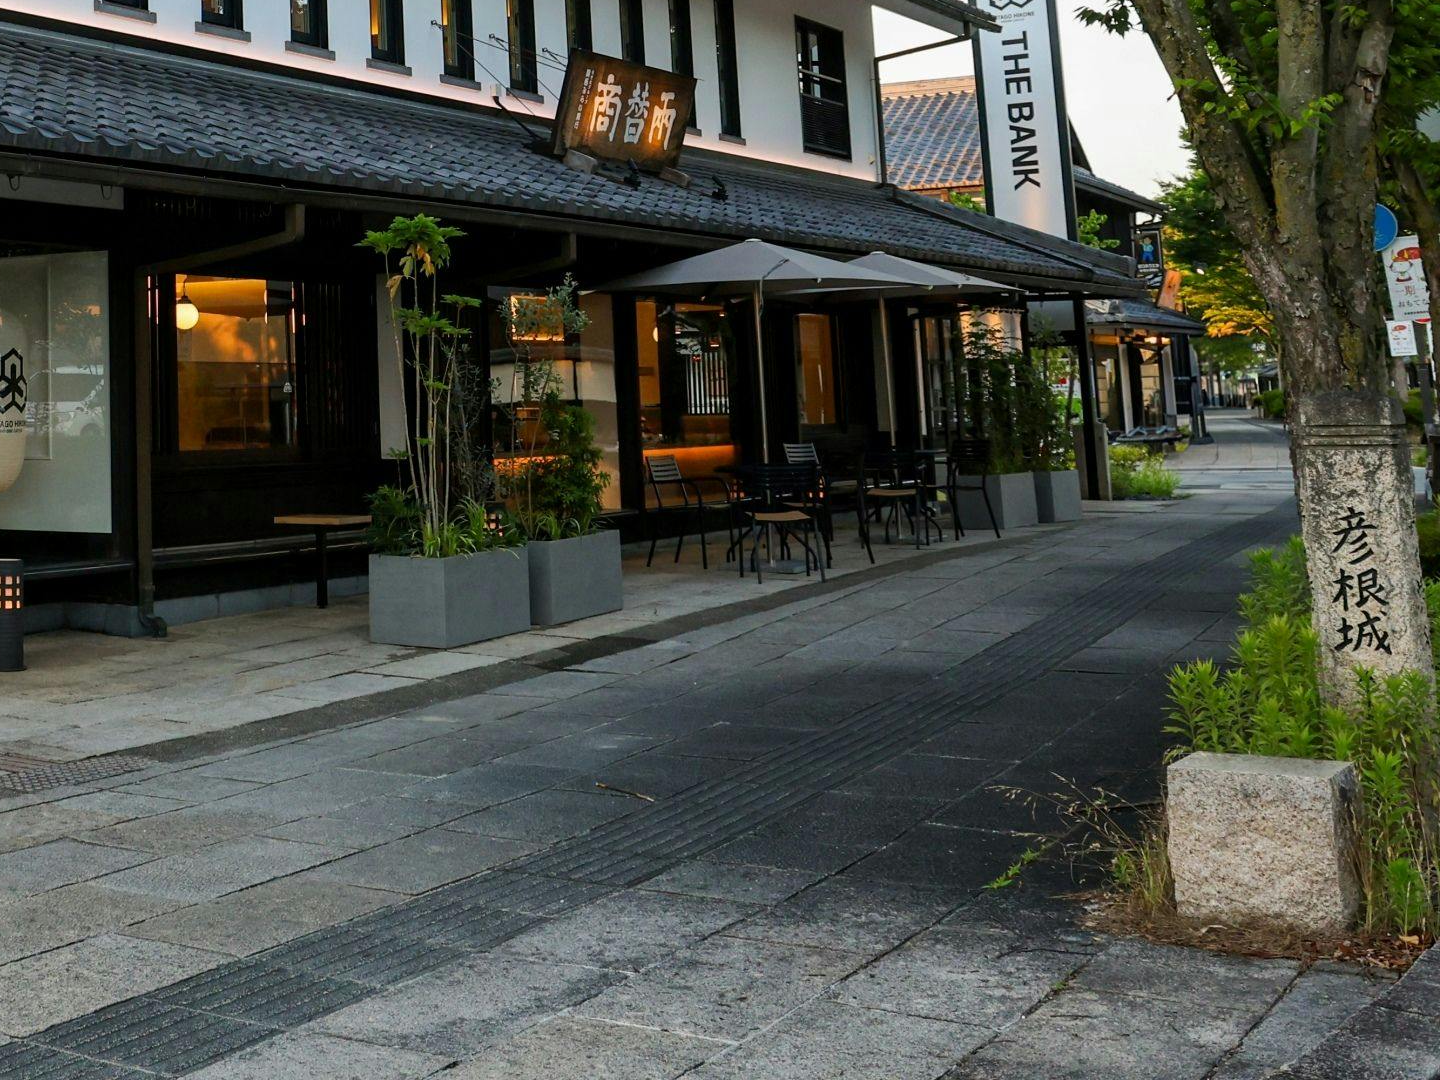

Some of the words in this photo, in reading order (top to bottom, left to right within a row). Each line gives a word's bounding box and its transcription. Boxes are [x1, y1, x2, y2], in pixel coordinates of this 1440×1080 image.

[1002, 31, 1032, 95] THE
[1007, 102, 1041, 191] BANK
[1331, 506, 1393, 656] 彦根城
